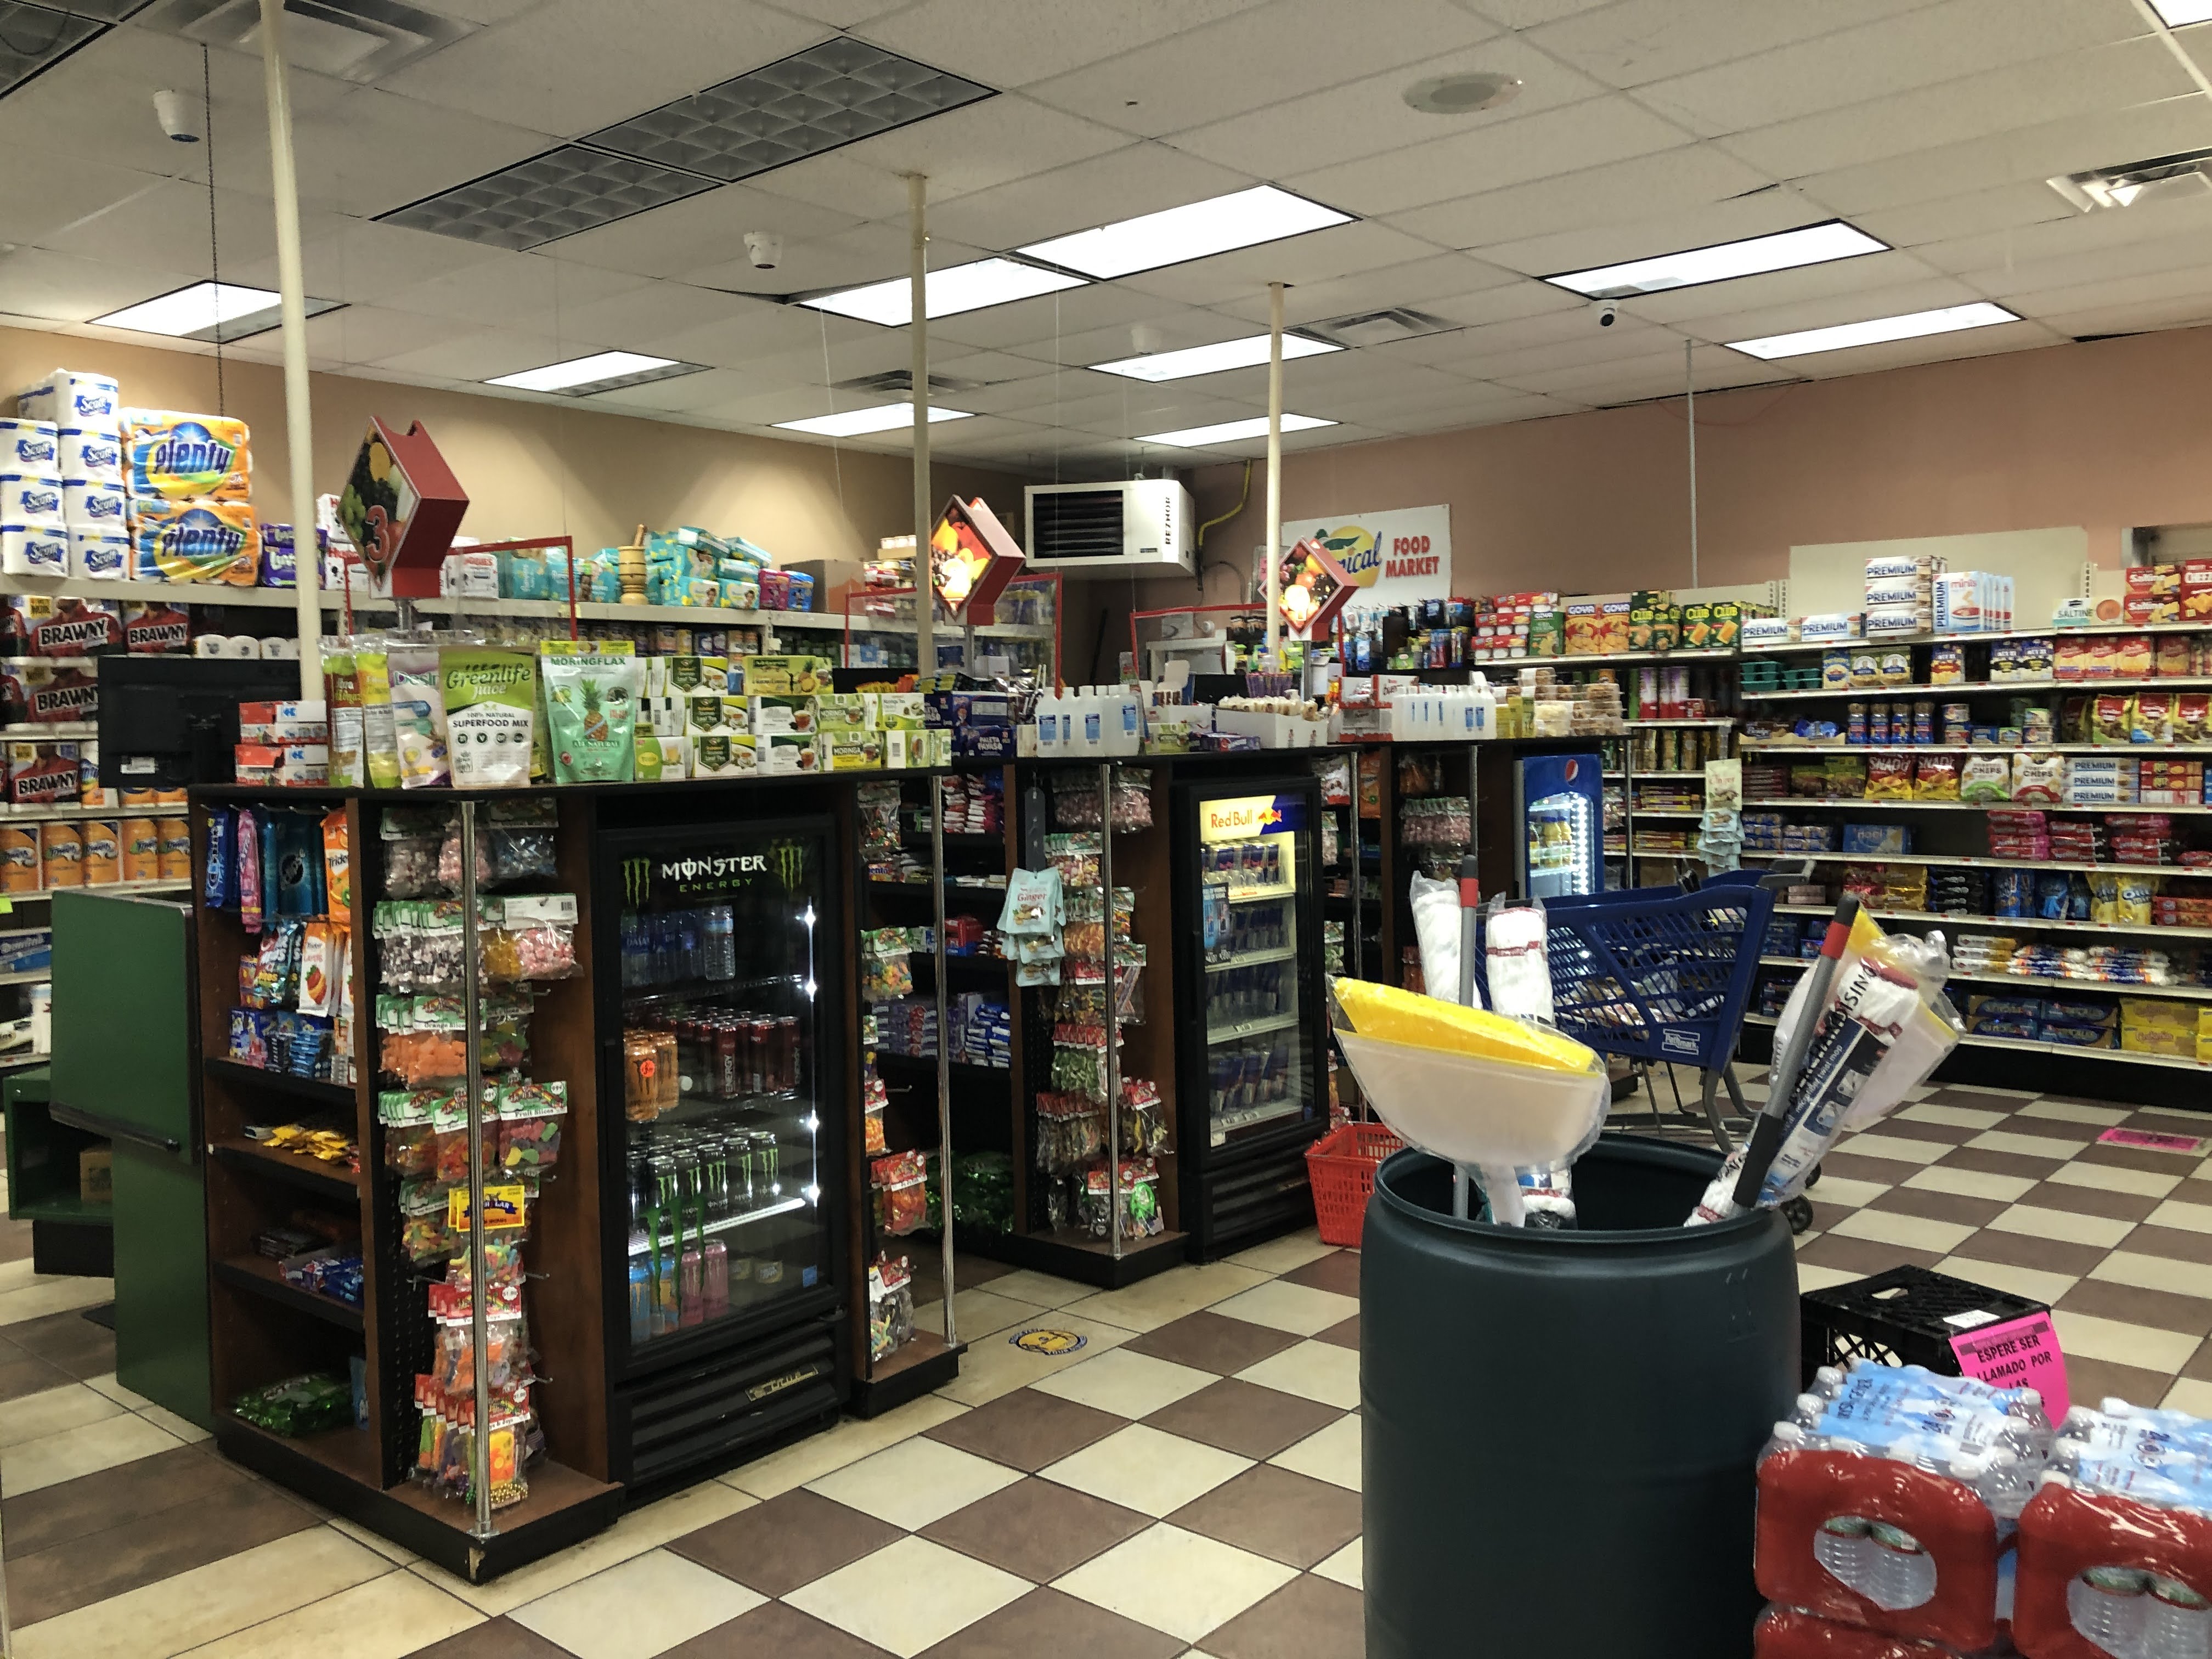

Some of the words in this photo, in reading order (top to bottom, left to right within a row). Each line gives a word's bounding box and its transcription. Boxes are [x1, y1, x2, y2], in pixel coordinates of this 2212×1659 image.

[80, 396, 108, 413] Scott
[22, 441, 52, 457] Scott
[87, 446, 114, 461] Scott
[153, 438, 231, 474] plenty
[27, 492, 56, 508] Scott
[92, 496, 120, 512] Scott
[161, 526, 241, 557] plenty
[365, 505, 390, 563] 3
[31, 541, 60, 558] Scott
[1393, 535, 1431, 556] FOOD
[91, 549, 119, 565] Scott
[1385, 556, 1440, 578] MARKET
[1867, 565, 1917, 574] PREMIUM
[1867, 591, 1916, 601] PREMIUM
[1568, 605, 1595, 614] GOYA
[1604, 603, 1630, 613] GOYA
[1714, 606, 1738, 618] CLUB
[1937, 582, 1945, 627] PREMIUM
[1631, 610, 1654, 622] CLUB
[1686, 608, 1709, 620] CLUB
[41, 617, 108, 645] BRAWNY
[1743, 626, 1787, 635] PREMIUM
[1803, 622, 1847, 632] PREMIUM
[1867, 618, 1917, 628] PREMIUM
[129, 624, 187, 644] BRAWNY
[447, 663, 531, 689] Greenlife
[472, 685, 507, 701] juice
[453, 719, 509, 728] SUPERFOOD
[833, 746, 861, 754] MORINGA
[18, 772, 78, 795] BRAWNY
[2073, 792, 2114, 800] PREMIUM
[1211, 811, 1232, 828] Red
[1233, 809, 1252, 826] Bull
[661, 855, 768, 881] MONSTER
[679, 878, 753, 893] ENERGY
[1017, 892, 1048, 902] Ginger
[1827, 1043, 1844, 1063] mop
[724, 1054, 734, 1093] ENERGY
[1976, 1340, 2019, 1363] ESPERE
[2019, 1334, 2041, 1351] SER
[1977, 1358, 2026, 1383] LLAMADO
[2030, 1351, 2053, 1368] POR
